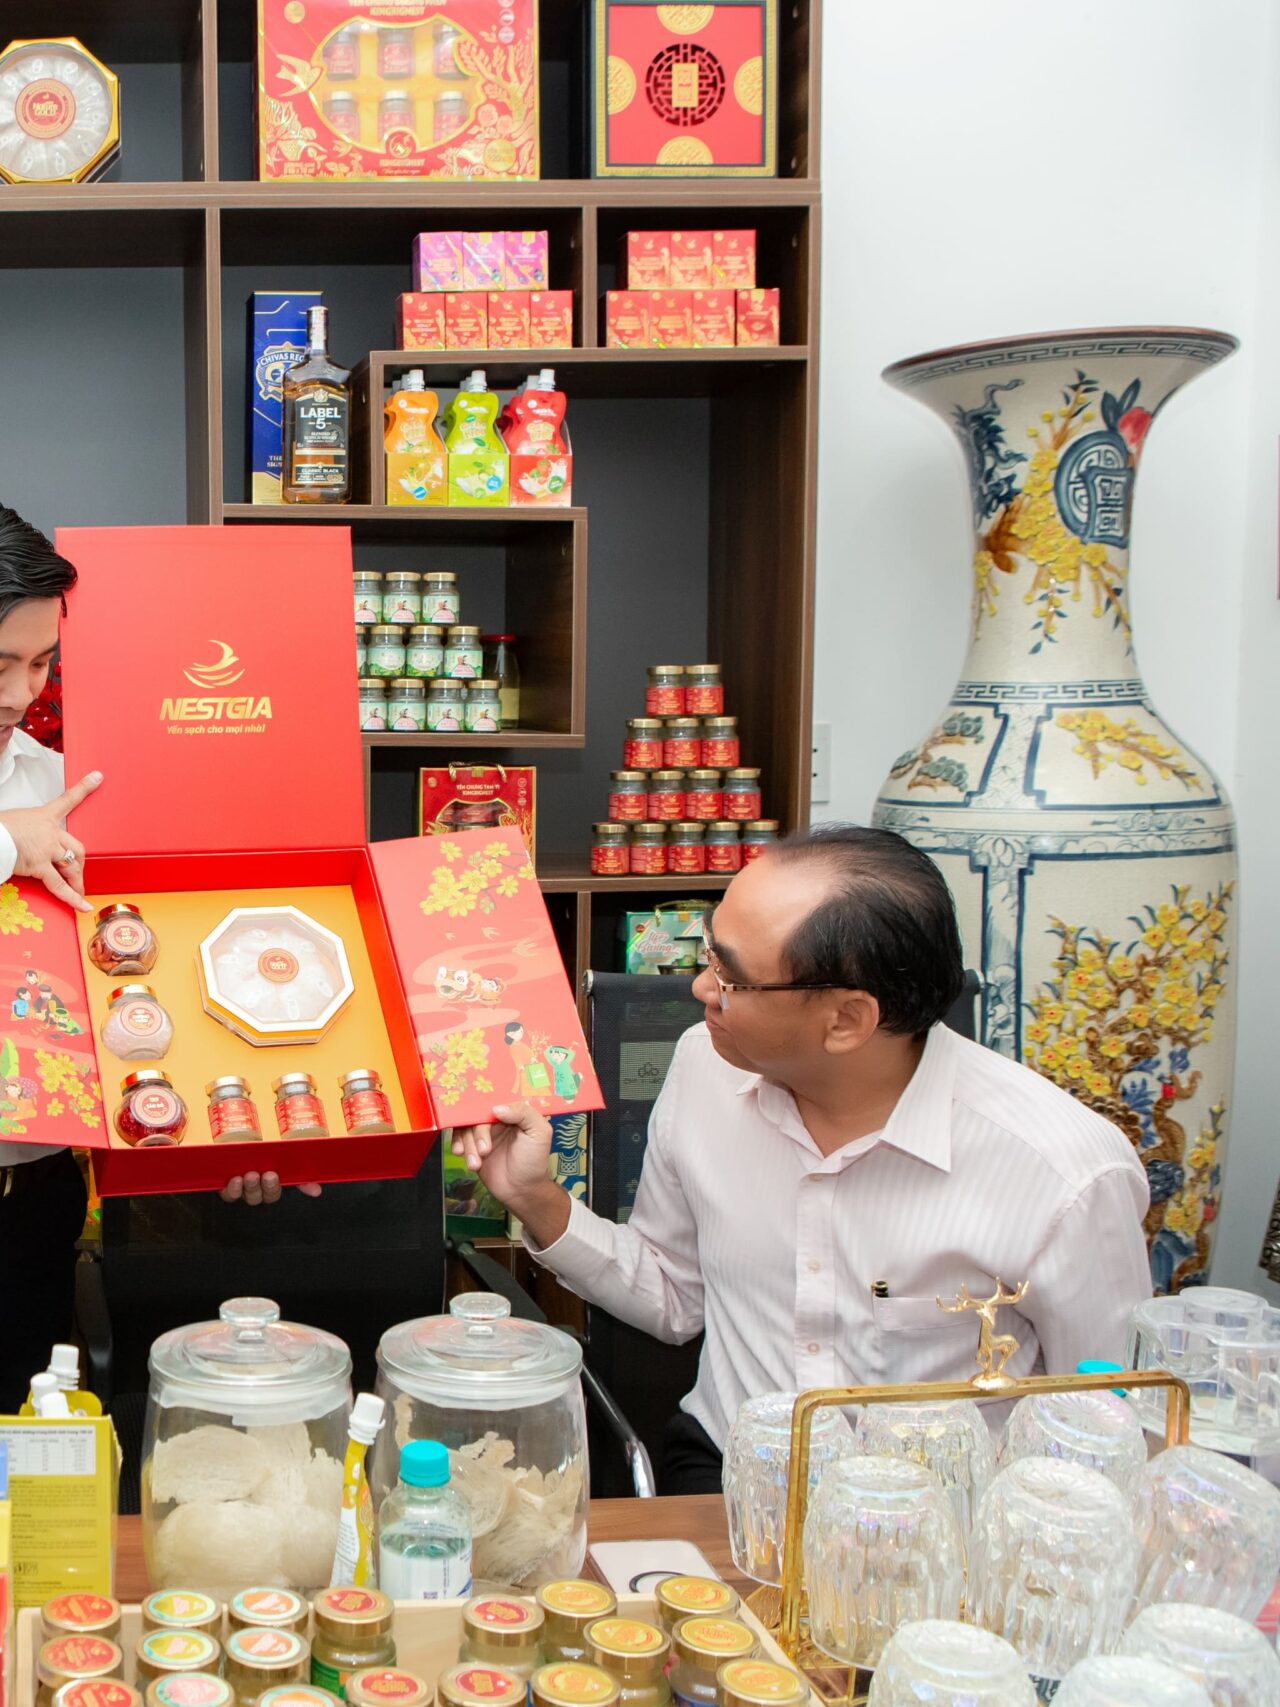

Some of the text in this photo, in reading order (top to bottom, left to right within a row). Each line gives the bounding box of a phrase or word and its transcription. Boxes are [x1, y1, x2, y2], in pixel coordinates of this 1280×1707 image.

[260, 352, 289, 366] CHIVAS
[300, 407, 342, 418] LABEL
[316, 418, 326, 430] 5
[160, 696, 272, 720] NESTGIA
[184, 724, 206, 735] sạch
[207, 724, 223, 734] cho
